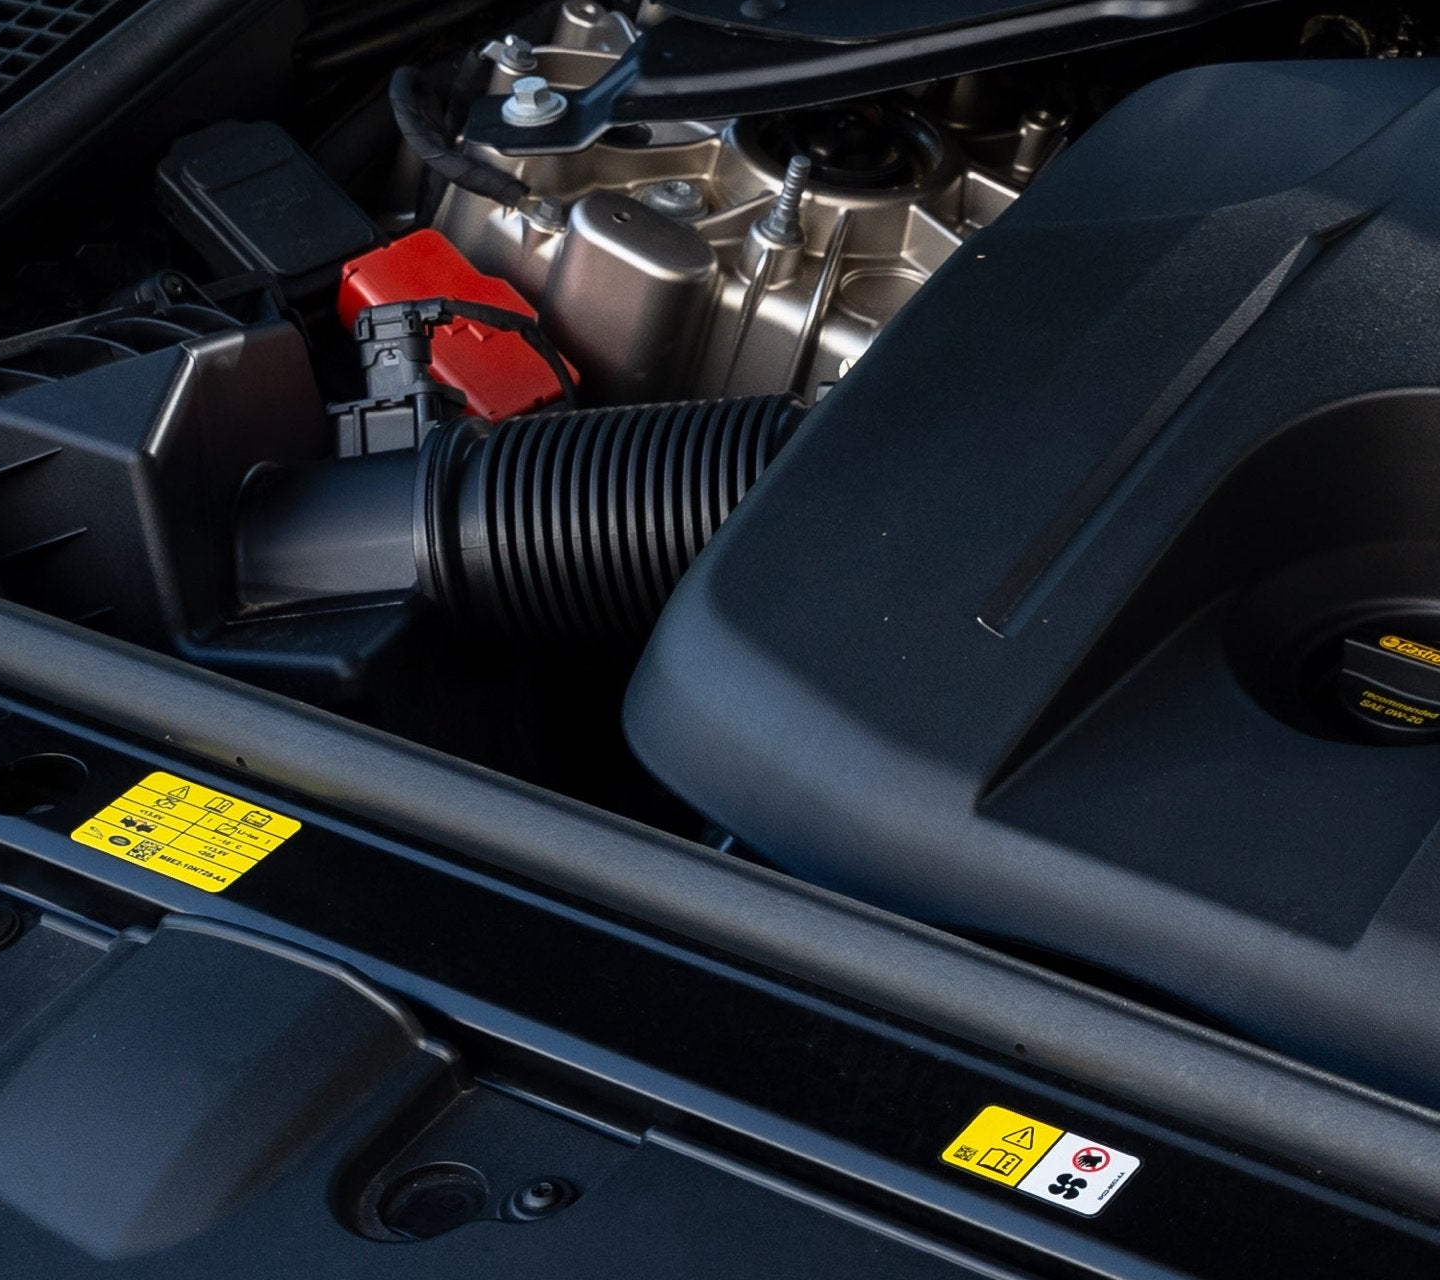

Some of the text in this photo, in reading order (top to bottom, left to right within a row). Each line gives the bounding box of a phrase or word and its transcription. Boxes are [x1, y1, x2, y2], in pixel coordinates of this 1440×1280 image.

[1360, 699, 1425, 724] SAE 0W-20
[1362, 690, 1440, 720] recommended
